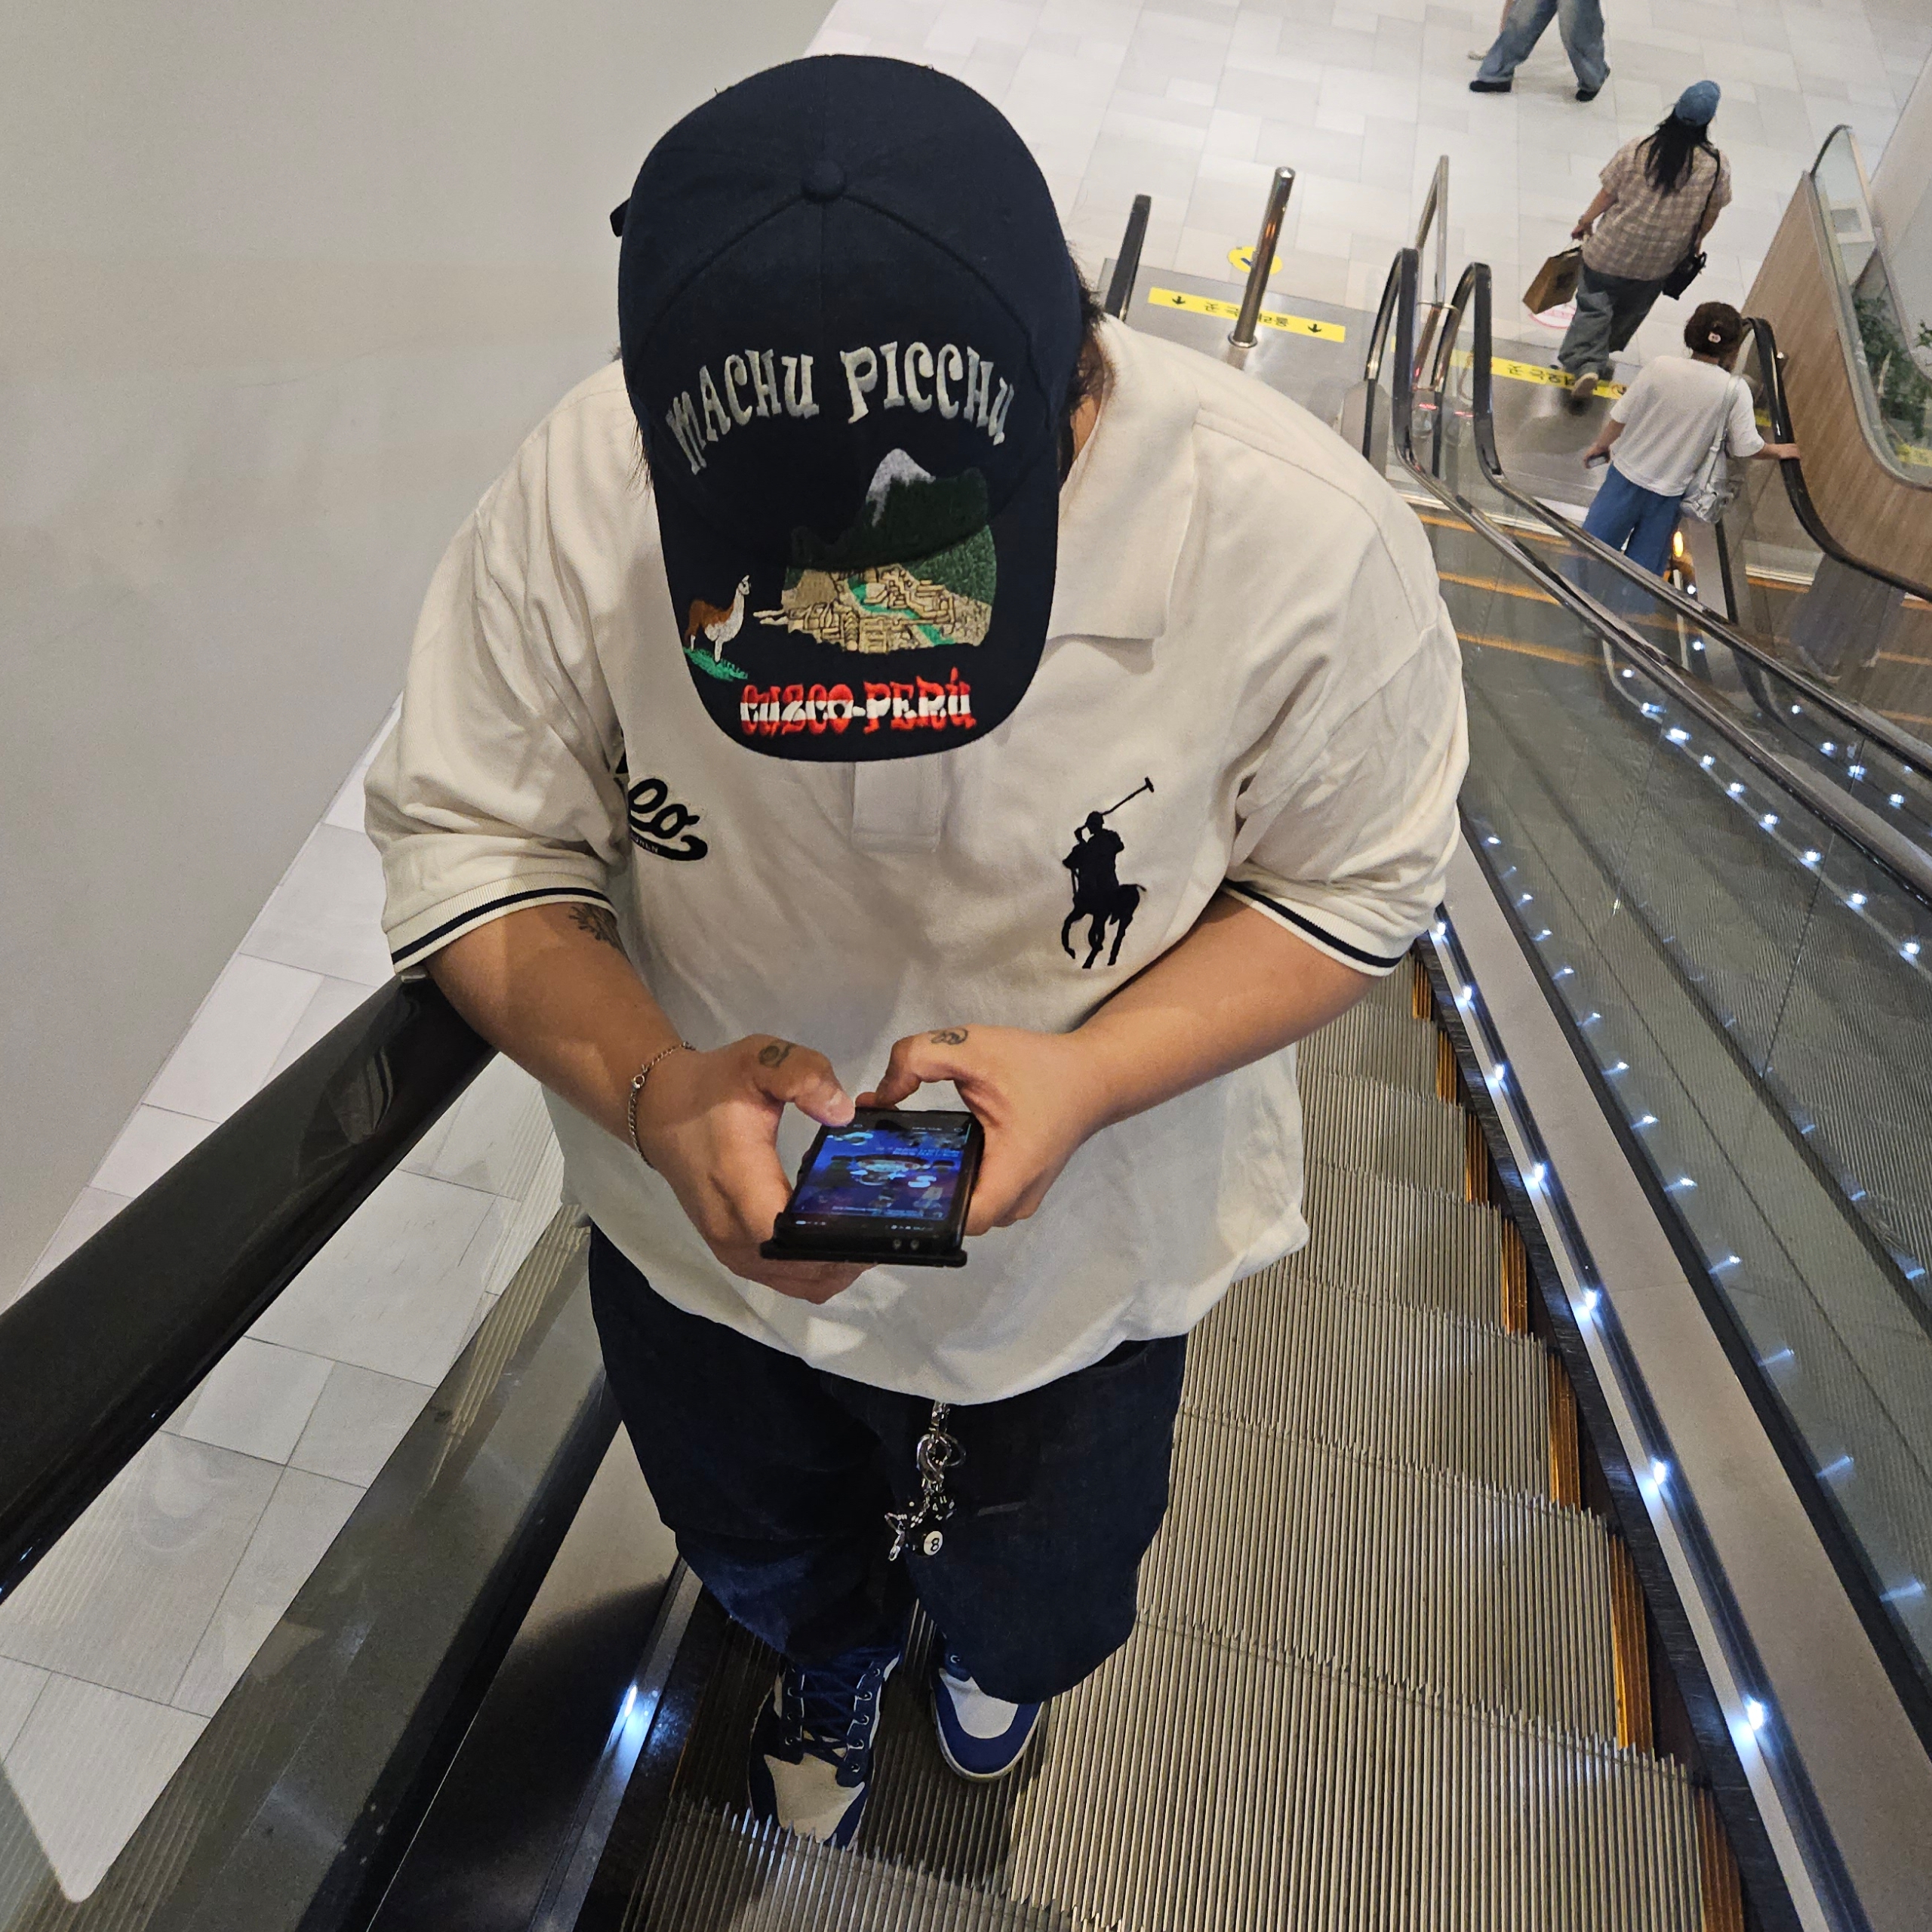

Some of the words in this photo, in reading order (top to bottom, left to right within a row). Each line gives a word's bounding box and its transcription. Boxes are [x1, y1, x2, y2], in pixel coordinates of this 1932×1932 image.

[666, 348, 820, 475] MACHU
[839, 340, 1014, 446] PICCHU
[930, 1537, 940, 1552] 8
